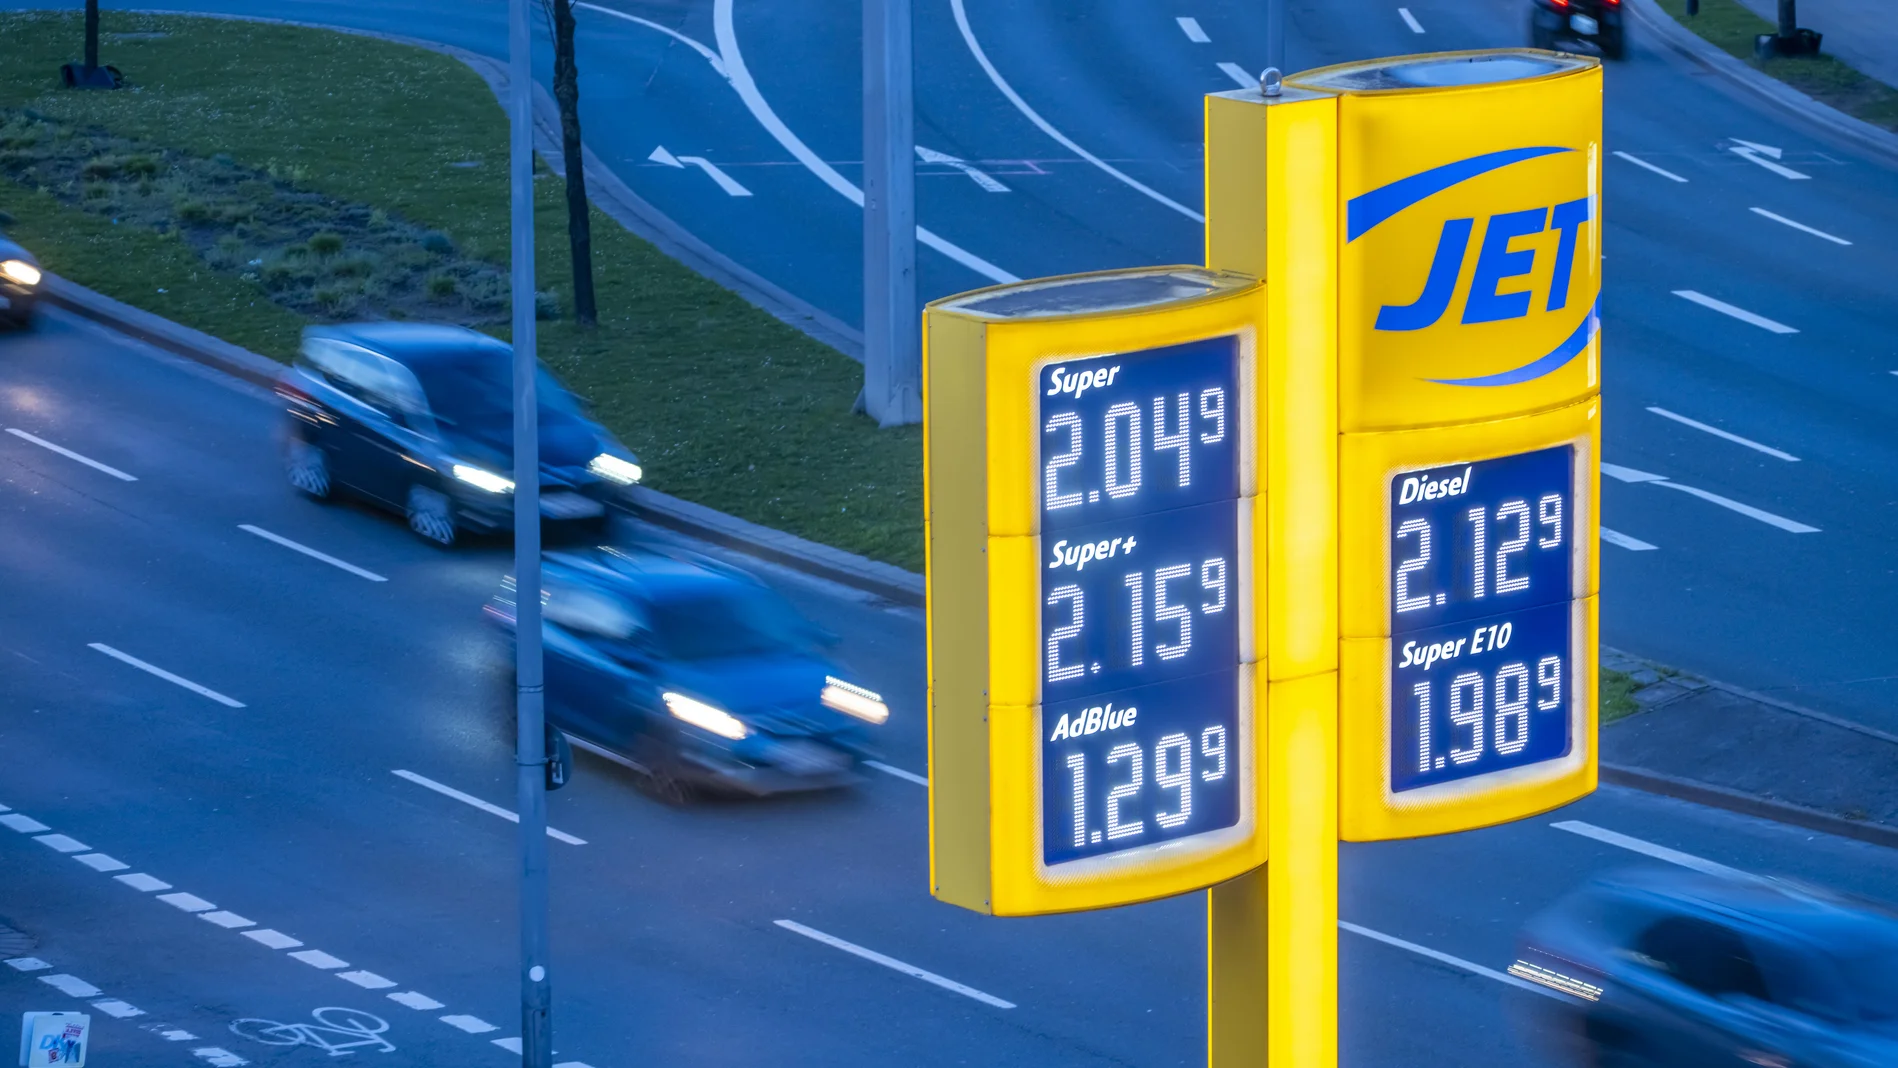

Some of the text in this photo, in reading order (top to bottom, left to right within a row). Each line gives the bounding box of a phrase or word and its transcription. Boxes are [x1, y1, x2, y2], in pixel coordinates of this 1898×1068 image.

[1374, 194, 1598, 331] JET
[1046, 363, 1121, 399] Super
[1398, 466, 1473, 505] Diesel
[1049, 535, 1137, 572] Super+
[1398, 621, 1513, 671] Super E10
[1050, 703, 1138, 743] AdBlue
